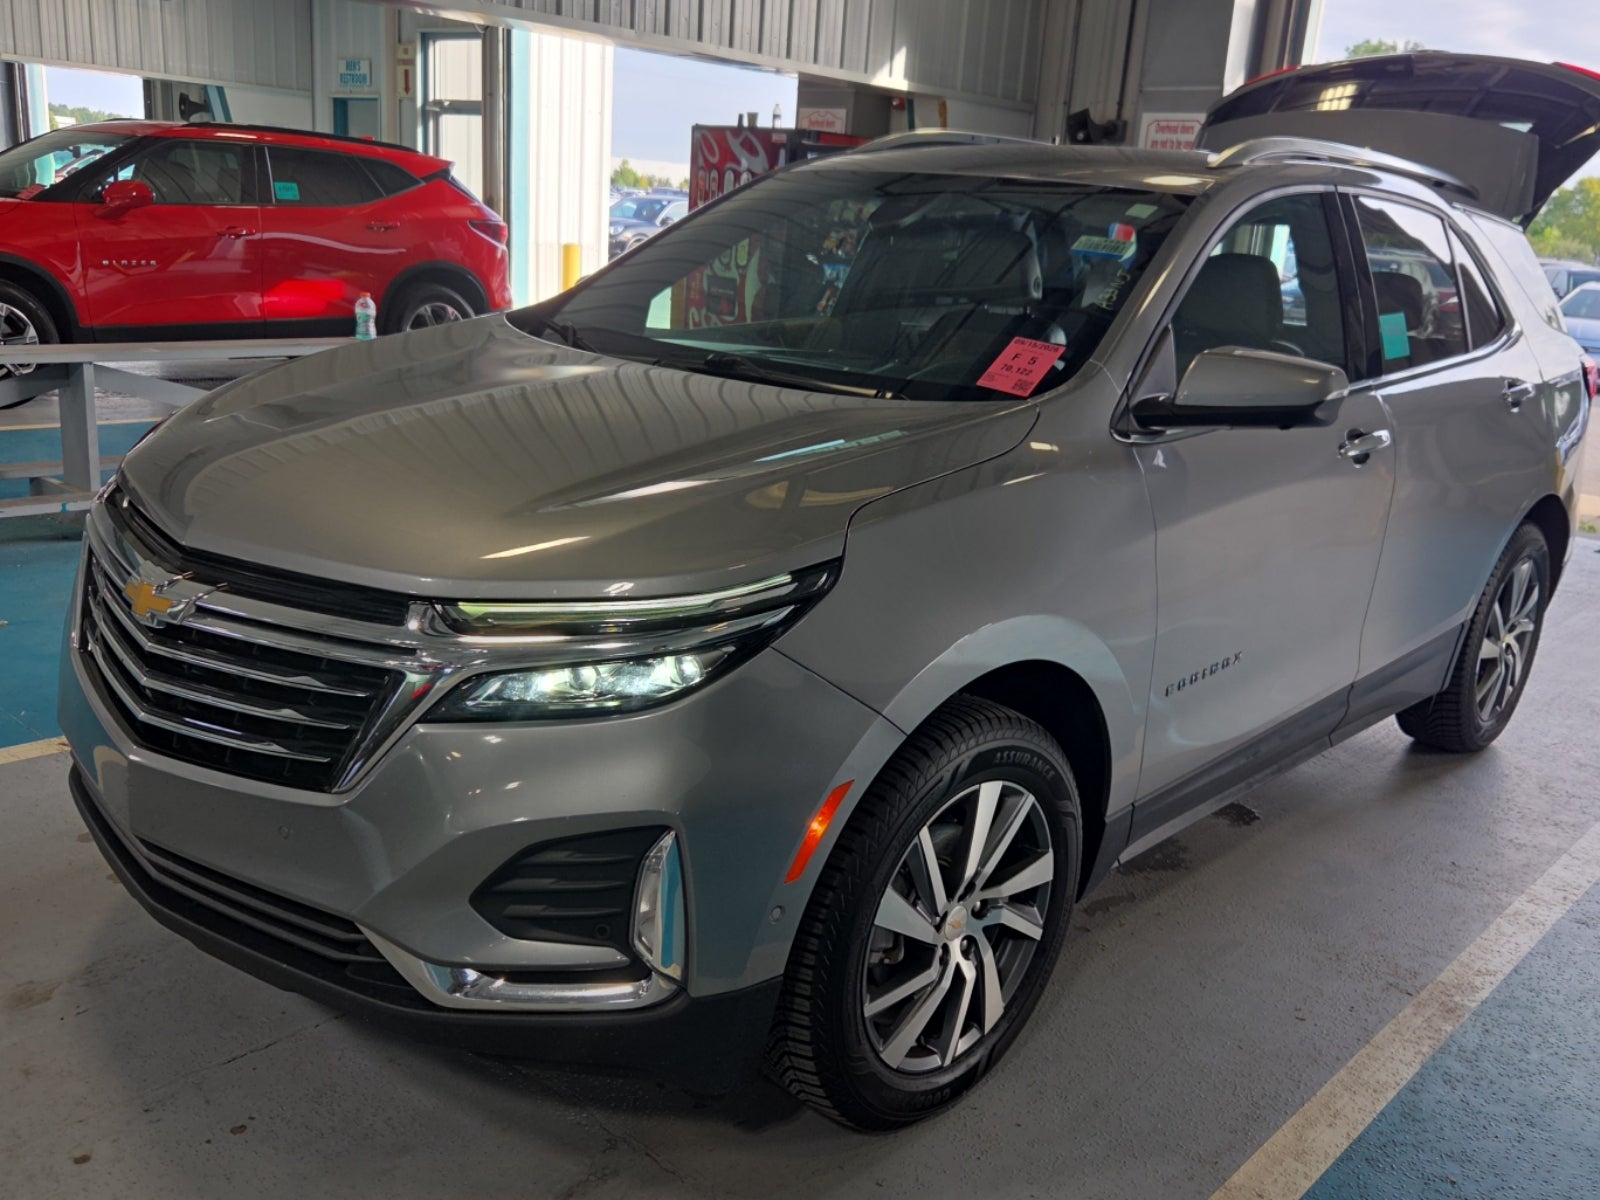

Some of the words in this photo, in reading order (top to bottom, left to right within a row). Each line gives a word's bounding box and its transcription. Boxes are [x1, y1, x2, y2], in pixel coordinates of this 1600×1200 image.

[339, 72, 368, 84] RESTROOM
[1154, 123, 1178, 135] Overhead
[1180, 123, 1195, 135] doors
[101, 259, 157, 267] BLAZER
[1011, 353, 1021, 361] F
[1027, 356, 1039, 366] 5
[1165, 651, 1242, 697] EQUINOX
